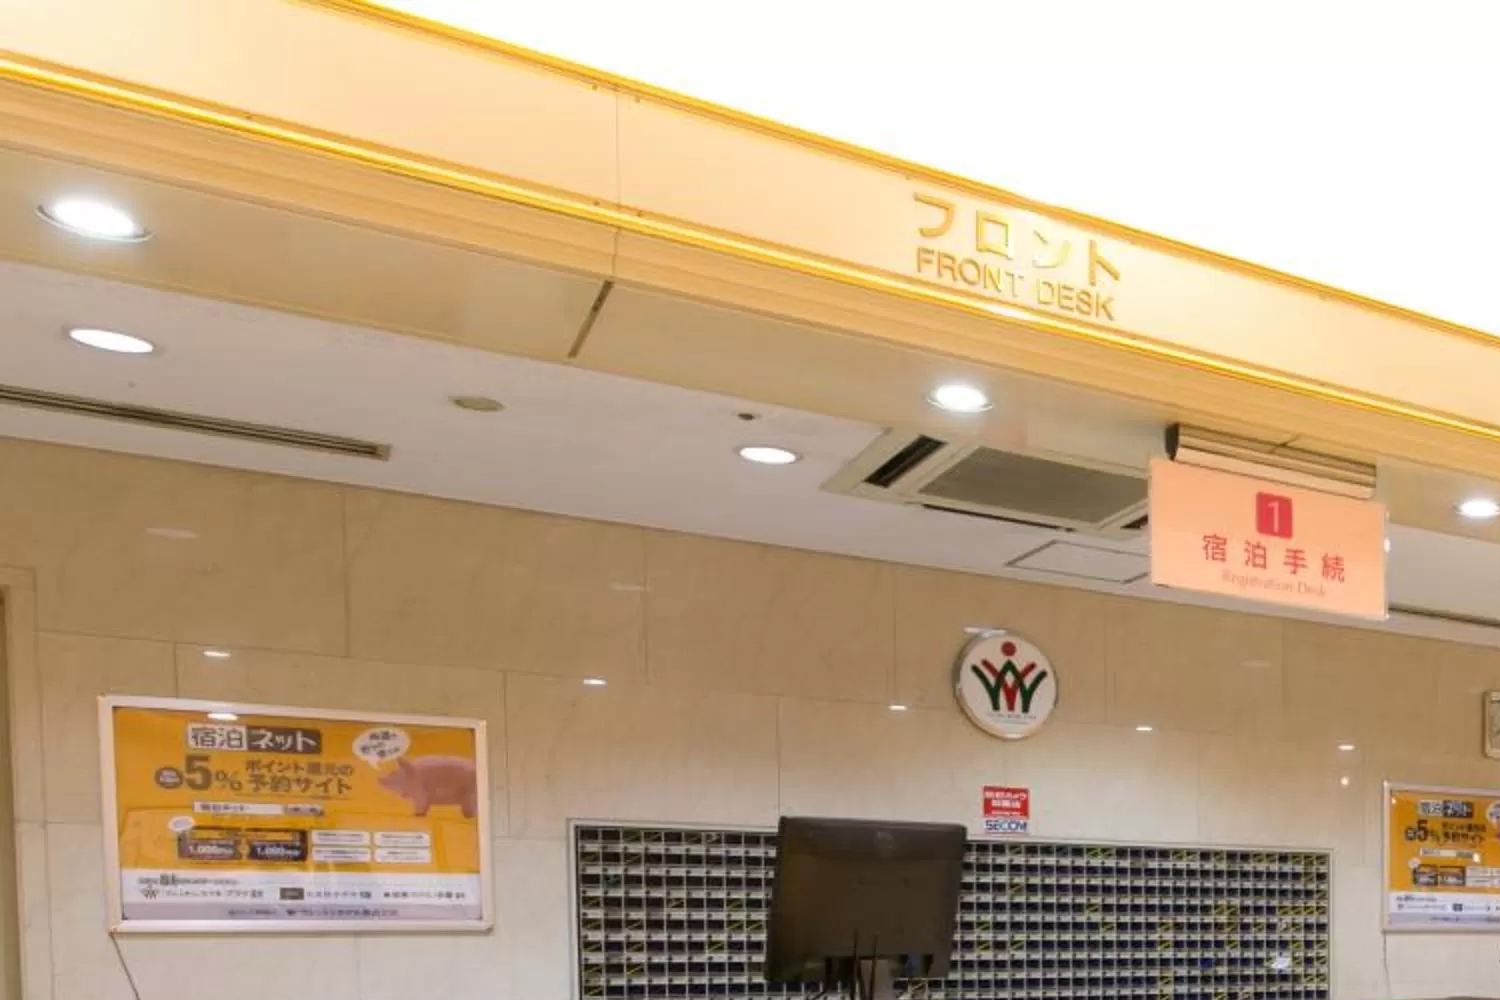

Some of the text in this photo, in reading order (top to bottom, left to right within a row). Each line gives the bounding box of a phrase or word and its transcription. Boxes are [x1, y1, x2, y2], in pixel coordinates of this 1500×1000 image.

[914, 191, 1120, 287] フロント
[916, 246, 1116, 322] FRONT DESK
[1267, 501, 1280, 533] 1
[1202, 534, 1346, 584] 宿泊手続
[191, 726, 317, 752] 宿泊ネット
[247, 774, 353, 795] 予約サイト
[985, 819, 1028, 832] SECOM
